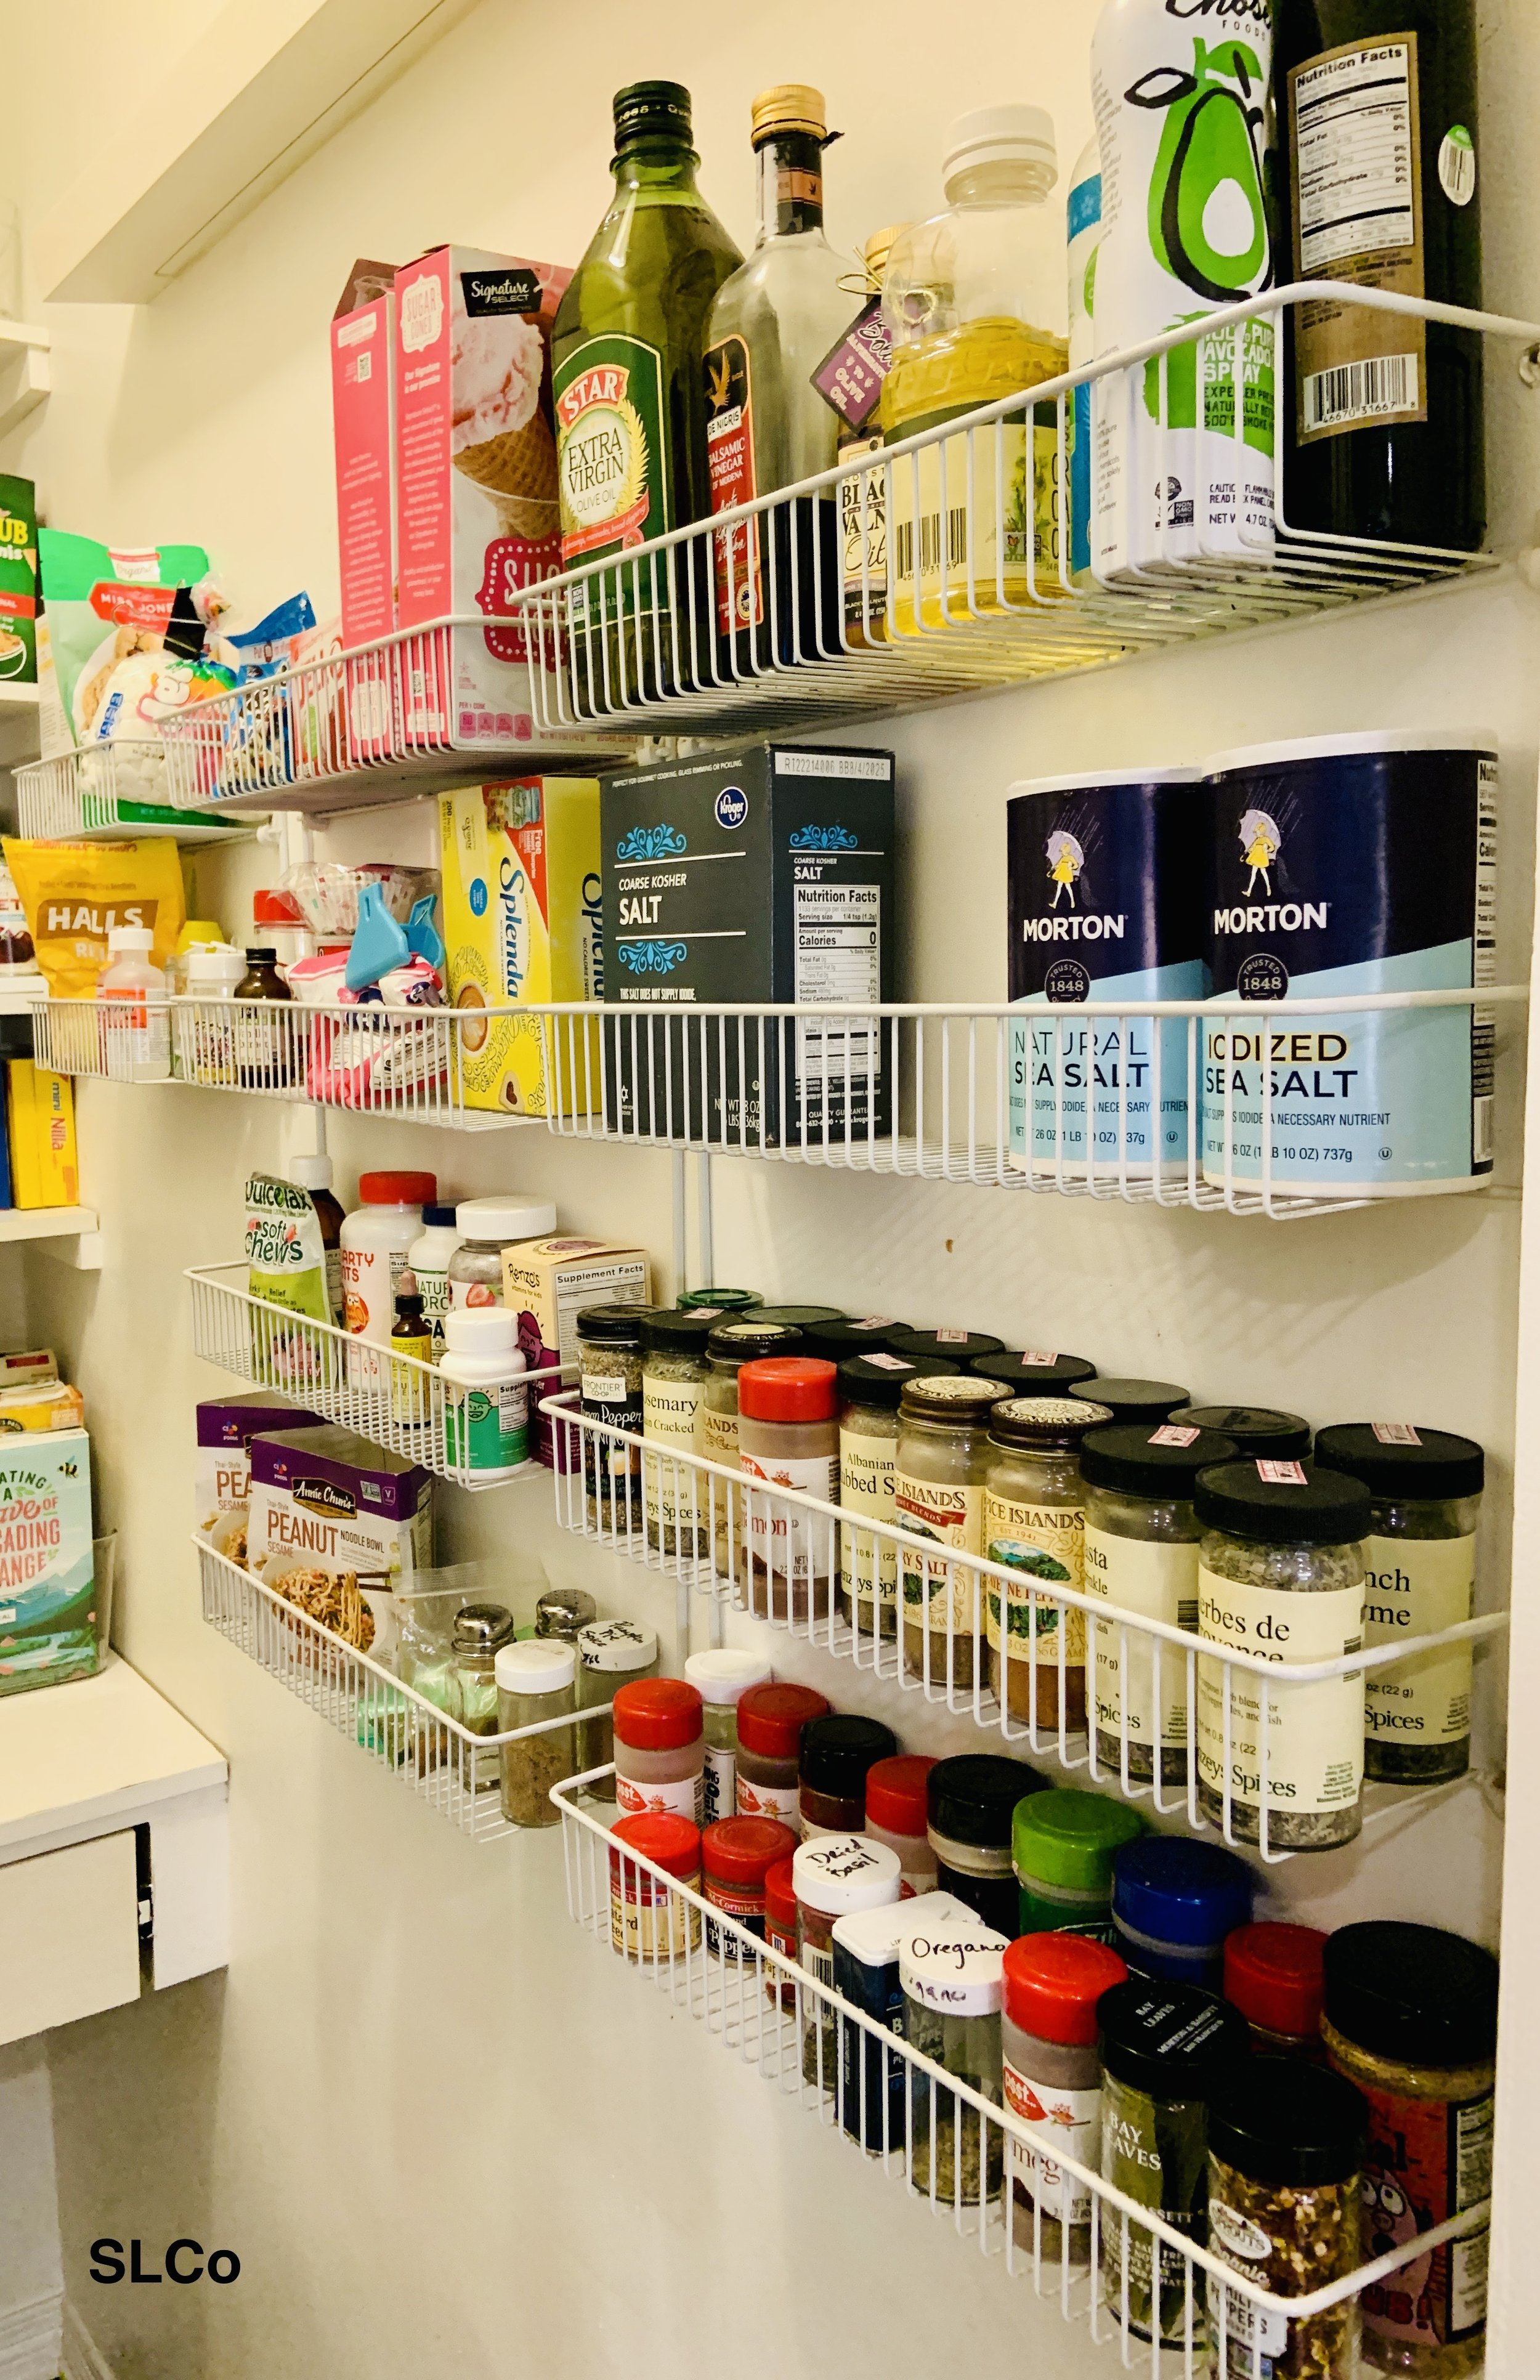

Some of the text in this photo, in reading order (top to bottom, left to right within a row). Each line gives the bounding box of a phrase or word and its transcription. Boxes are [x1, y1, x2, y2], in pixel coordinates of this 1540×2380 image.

[1297, 46, 1403, 87] Nutrition Facts
[471, 279, 529, 304] Signature
[492, 294, 530, 304] SELECT
[564, 372, 618, 420] STAR
[835, 367, 865, 403] OLIVE
[830, 386, 848, 410] OIL
[716, 411, 740, 432] NIGRIS
[568, 427, 622, 472] EXTRA
[708, 437, 746, 466] BALSAMIC
[568, 452, 623, 494] VIRGIN
[710, 455, 744, 479] VINEGAR
[576, 487, 617, 513] OLIVE OIL
[720, 760, 744, 771] PICKLING.
[720, 794, 744, 822] Kroger
[618, 873, 687, 891] COARSE KOSHER
[793, 866, 823, 880] SALT
[798, 889, 877, 903] Nutrition Facts
[47, 907, 144, 934] HALLS
[619, 896, 662, 925] SALT
[798, 913, 820, 921] Serving
[862, 913, 877, 921] (1.2g)
[1214, 902, 1327, 935] MORTON
[500, 857, 524, 1000] Splenda
[798, 931, 877, 945] Calories 0
[1023, 914, 1125, 942] MORTON
[583, 937, 587, 948] NO
[1050, 963, 1084, 979] TRUSTED
[1243, 958, 1281, 975] TRUSTED
[629, 988, 639, 1000] SALT
[661, 988, 678, 1000] SUPPLY
[1050, 979, 1084, 992] 1848
[1244, 976, 1282, 990] 1848
[1208, 1034, 1348, 1062] IODIZED
[1064, 1063, 1149, 1088] SALT
[1206, 1067, 1358, 1098] SEA SALT
[52, 1082, 63, 1111] mini
[1277, 1112, 1391, 1126] NECESSARY NUTRIENT
[51, 1117, 66, 1151] Nilla
[1035, 1130, 1045, 1140] 26
[1047, 1130, 1056, 1141] OZ
[1069, 1131, 1081, 1142] LB
[1099, 1132, 1117, 1144] OZ)
[1239, 1144, 1353, 1162] OZ (1 10 OZ) 737g
[262, 1220, 287, 1239] soft
[508, 1262, 541, 1288] Renzo's
[557, 1265, 644, 1284] Supplement Facts
[584, 1380, 620, 1392] FRONTIER
[601, 1404, 644, 1428] Pepper
[654, 1418, 694, 1433] Cracked
[847, 1452, 894, 1471] Albanian
[43, 1497, 59, 1512] OF
[294, 1481, 355, 1510] Annie Chun's
[902, 1481, 966, 1510] ISLANDS
[912, 1504, 942, 1524] BLENDS
[1008, 1507, 1085, 1531] ISLANDS
[267, 1509, 385, 1557] PEANUT NOODLE BOWL
[1016, 1530, 1036, 1542] 1941
[267, 1542, 294, 1559] SESAME
[1256, 1614, 1291, 1641] de
[1096, 1652, 1119, 1670] (17 g)
[1382, 1684, 1399, 1695] (22
[1402, 1687, 1414, 1699] g)
[1364, 1703, 1424, 1731] Spices
[1240, 1742, 1257, 1755] (22
[806, 1838, 865, 1869] Dried
[911, 1937, 1005, 1969] Oregano
[1135, 2001, 1155, 2016] BAY
[1143, 2003, 1175, 2027] LEAVES
[1156, 2029, 1188, 2054] MORTON
[1109, 2110, 1143, 2144] BAY
